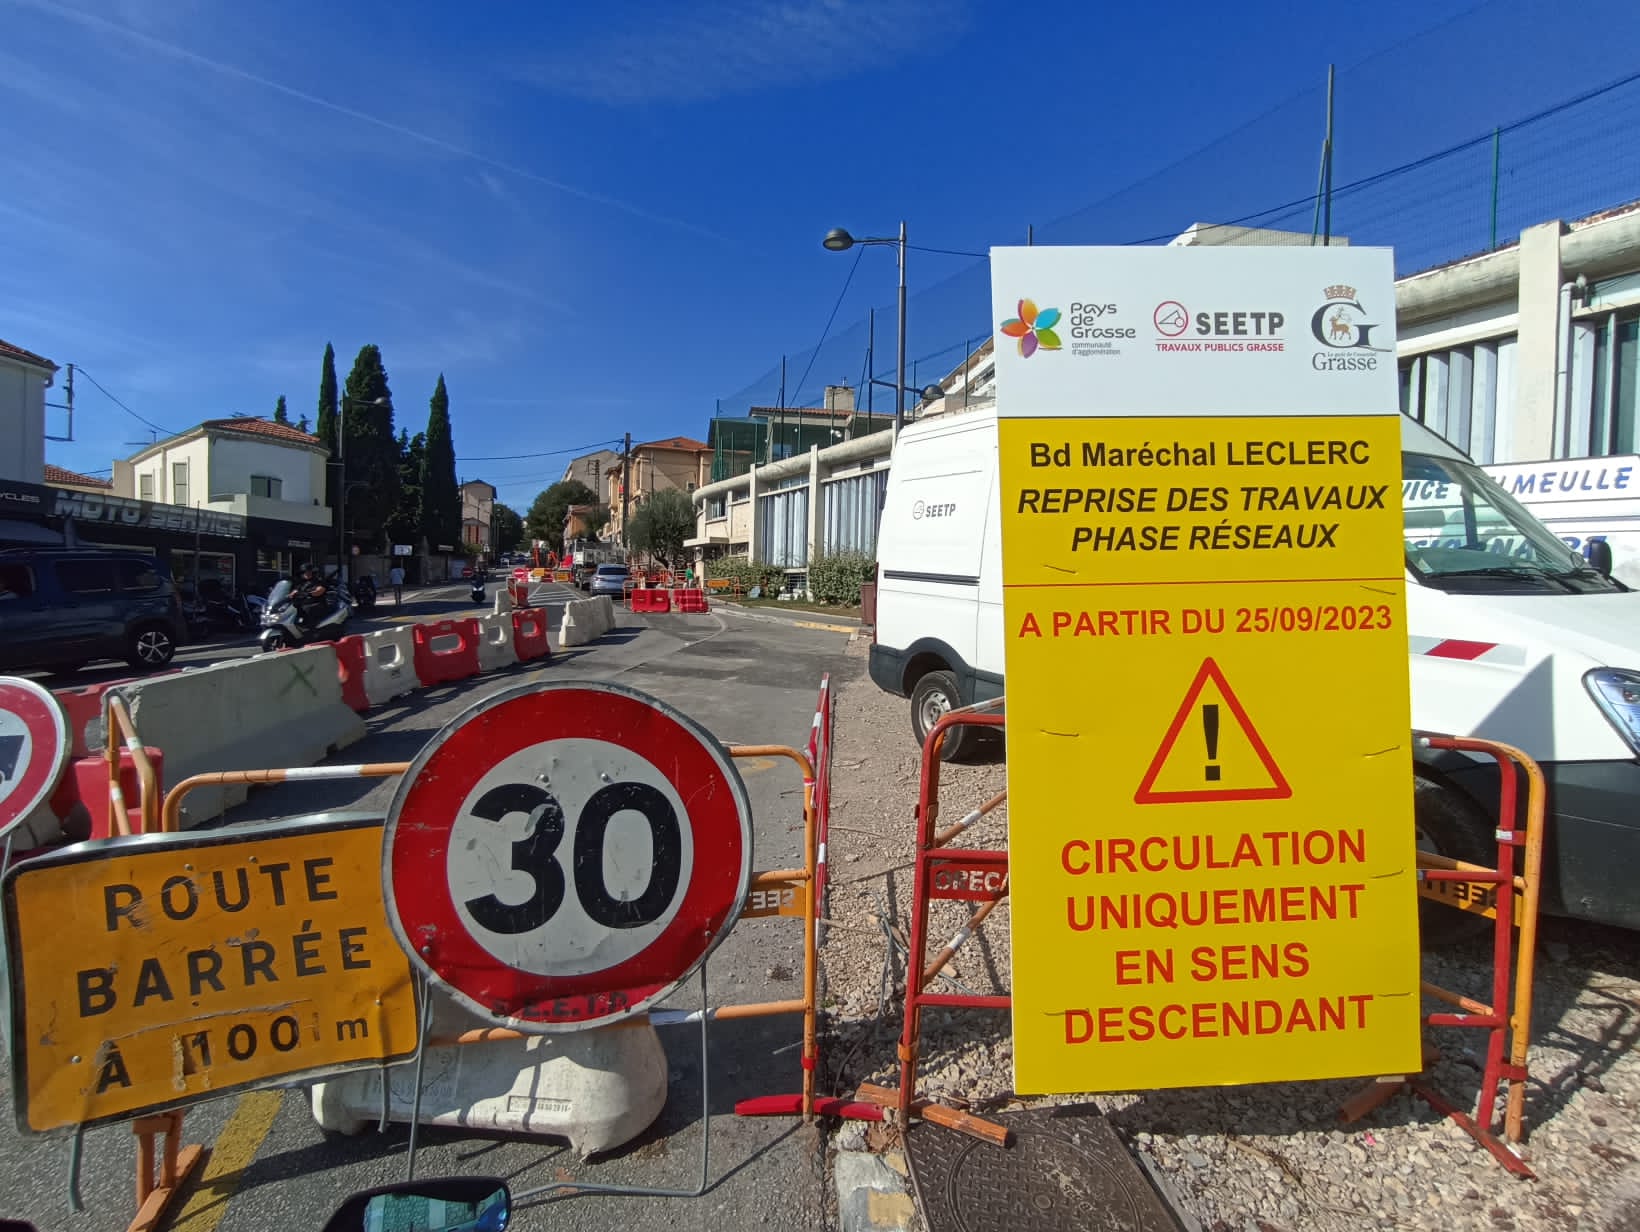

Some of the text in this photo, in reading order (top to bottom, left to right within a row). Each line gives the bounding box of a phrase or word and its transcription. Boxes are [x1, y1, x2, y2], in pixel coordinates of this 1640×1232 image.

[1070, 302, 1118, 317] Pays
[1070, 313, 1095, 327] de
[1195, 311, 1285, 336] SEETP
[1071, 327, 1137, 339] Grasse
[1156, 343, 1285, 352] TRAVAUX PUBLICS GRASSE
[1312, 351, 1377, 371] Grasse
[1030, 440, 1371, 467] Bd Maréchal LECLERC
[53, 490, 142, 524] MOTO
[925, 503, 957, 518] SEETP
[1017, 485, 1389, 514] REPRISE DES TRAVAUX
[1071, 518, 1339, 552] PHASE RÉSEAUX
[1018, 604, 1393, 638] A PARTIR DU 25/09/2023
[465, 781, 682, 935] 30
[1060, 828, 1367, 876] CIRCULATION
[104, 856, 338, 932] ROUTE
[1066, 883, 1366, 932] UNIQUEMENT
[77, 919, 373, 1018] BARRÉE
[1115, 942, 1311, 986] EN SENS
[336, 1016, 369, 1041] m
[1065, 994, 1374, 1045] DESCENDANT
